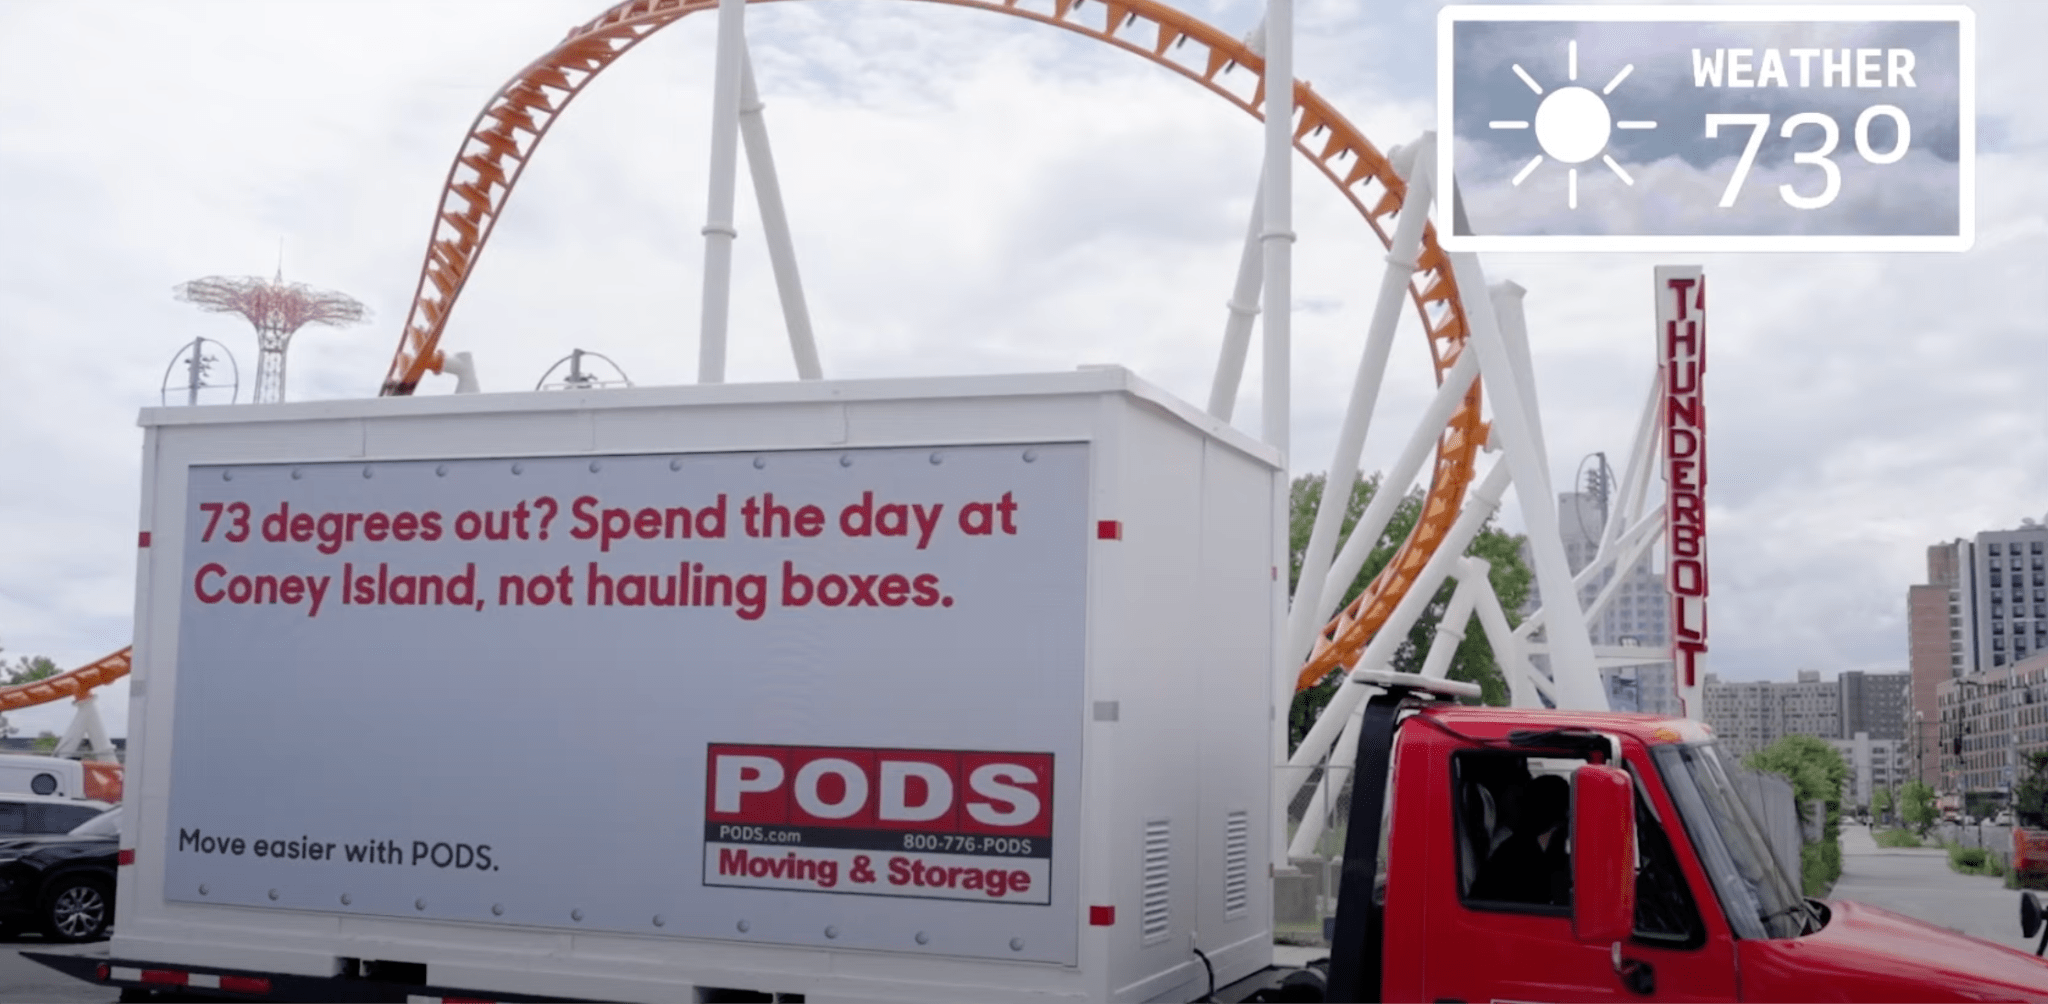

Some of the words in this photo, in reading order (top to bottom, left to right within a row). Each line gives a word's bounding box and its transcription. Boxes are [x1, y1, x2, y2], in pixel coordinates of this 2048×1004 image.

[1666, 278, 1708, 687] THUNDERBOLT
[200, 503, 251, 543] 73
[262, 502, 443, 556] degrees
[455, 497, 559, 541] out?
[570, 495, 727, 552] Spend
[741, 493, 827, 538] the
[839, 492, 943, 549] day
[958, 492, 1018, 536] at
[195, 563, 331, 617] Coney
[342, 563, 484, 611] Island,
[498, 566, 573, 606] not
[586, 561, 768, 621] hauling
[781, 561, 954, 608] boxes.
[715, 755, 1041, 826] PODS
[178, 827, 247, 856] Move
[253, 834, 337, 861] easier
[344, 838, 404, 866] with
[411, 840, 500, 872] PODS.
[719, 825, 802, 844] PODS.com
[903, 834, 1032, 854] 800-776-PODS
[718, 848, 838, 888] Moving
[849, 855, 877, 884] &
[887, 856, 1031, 898] Storage
